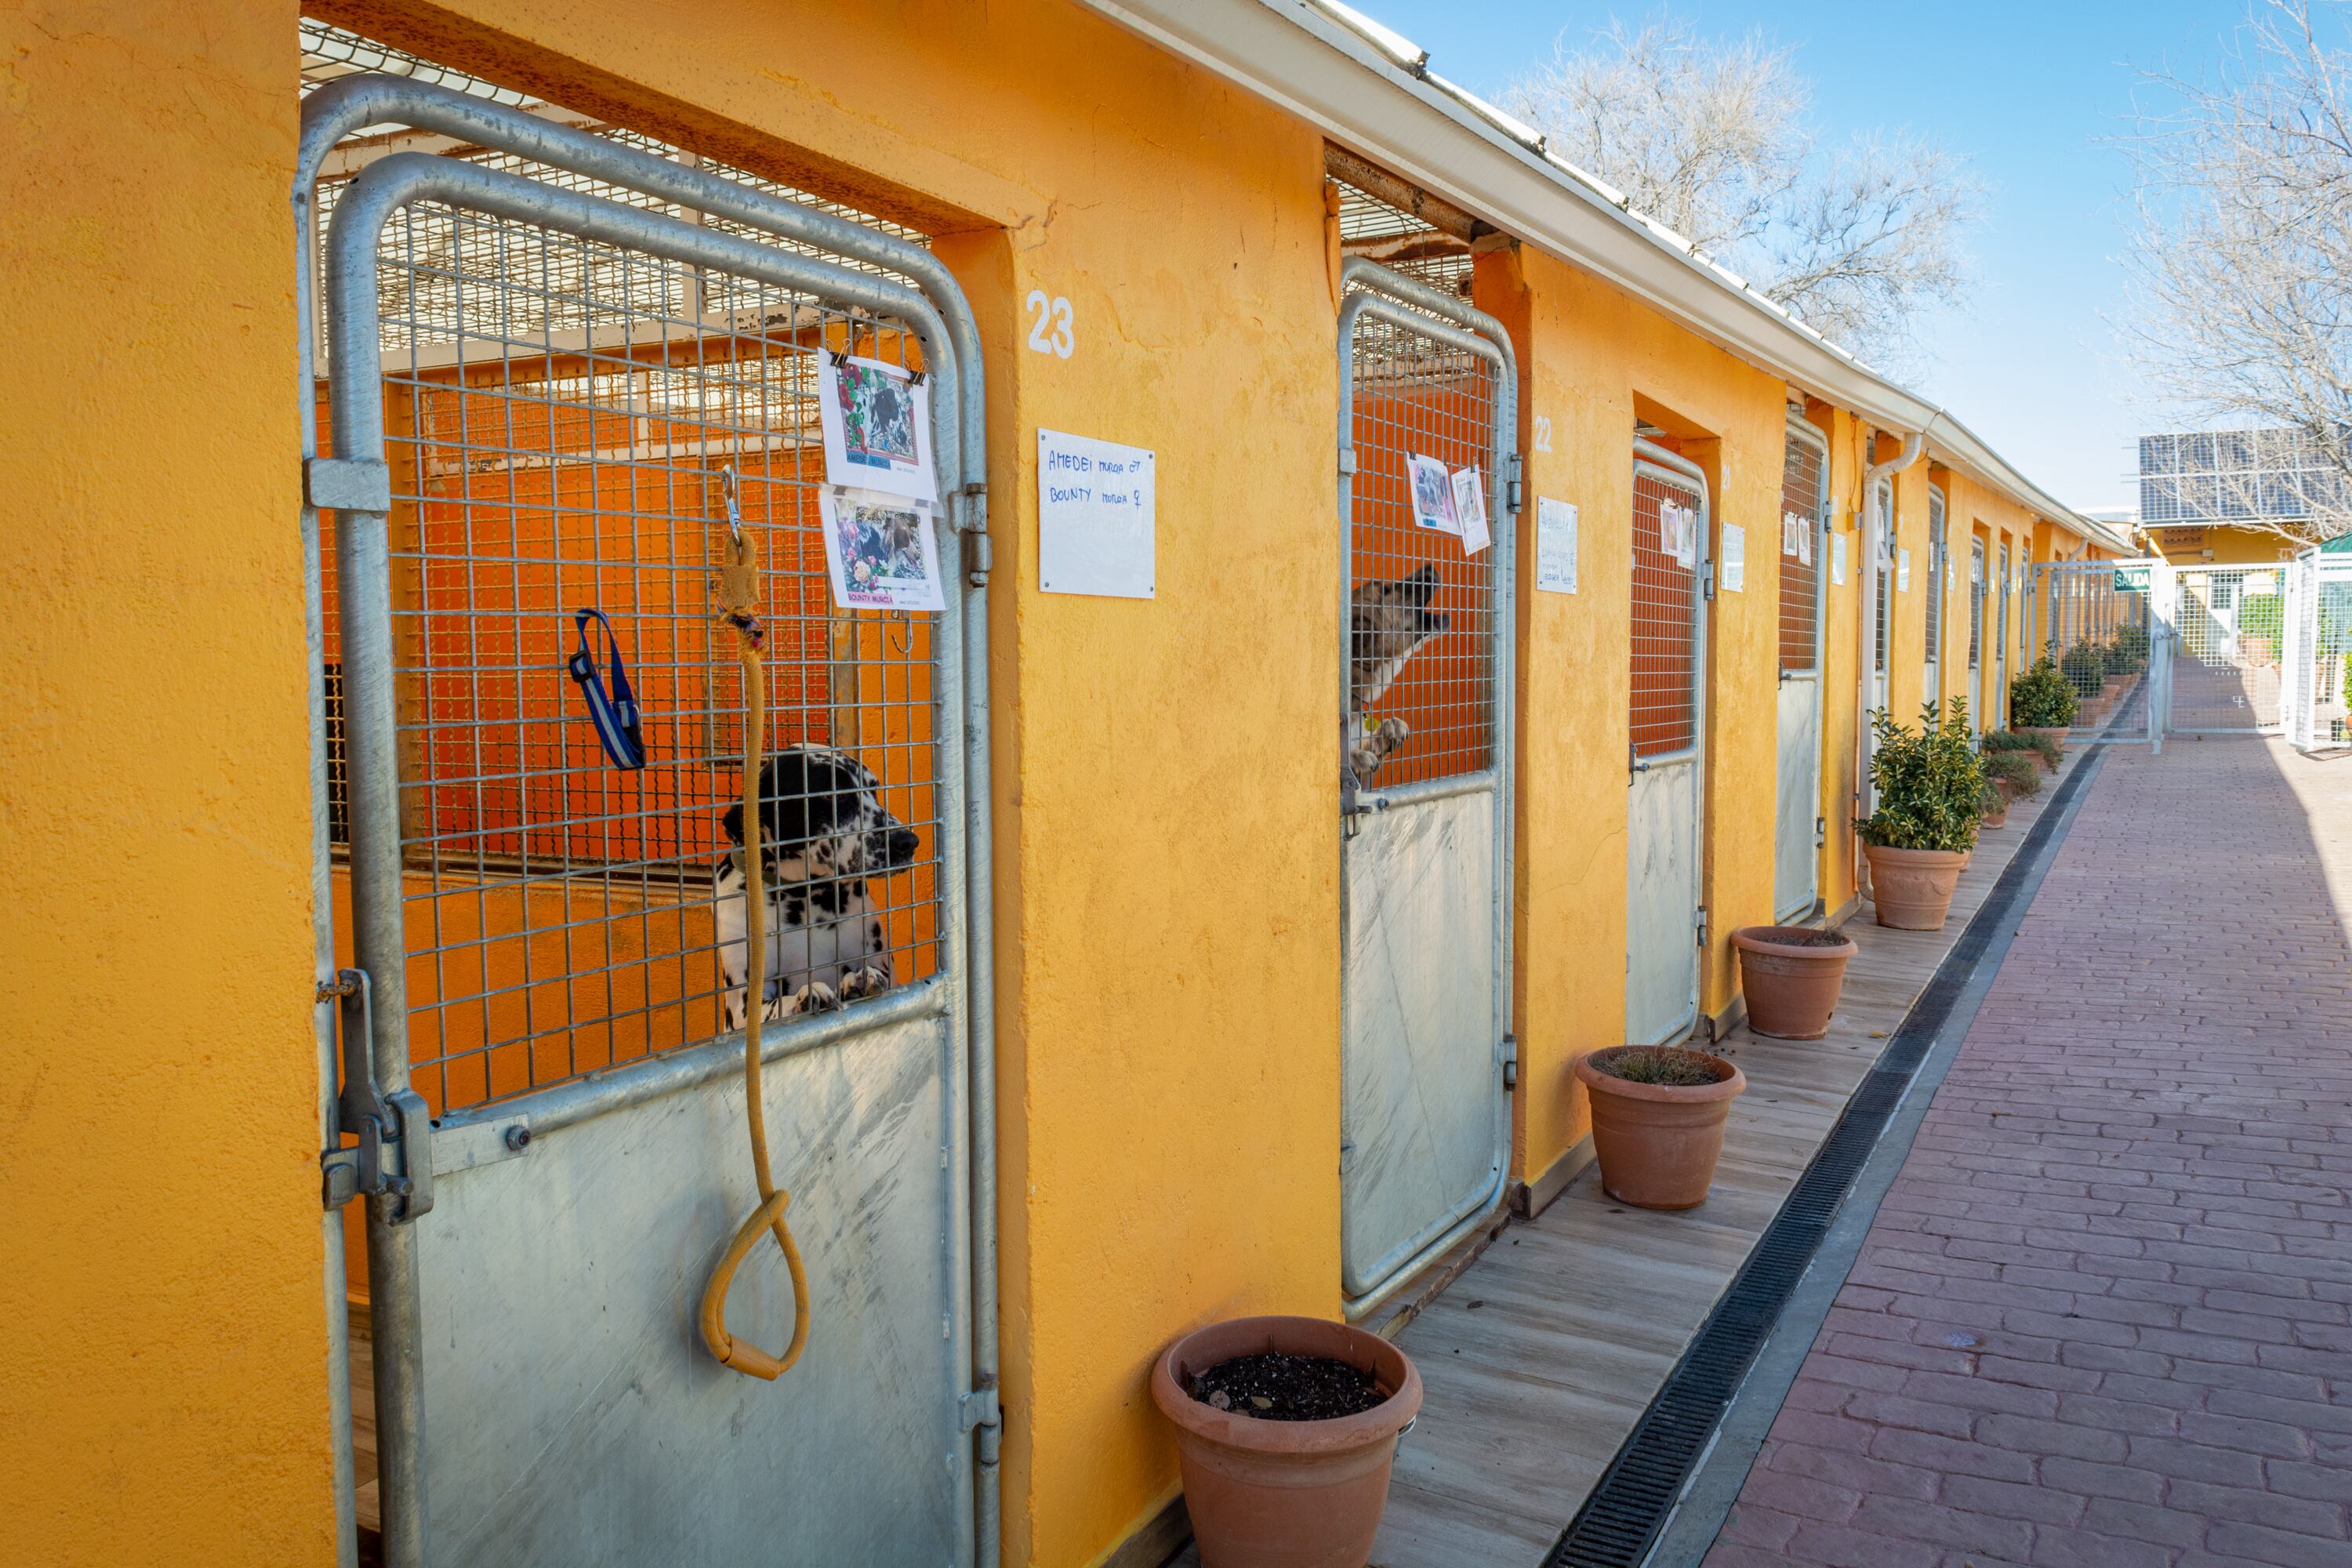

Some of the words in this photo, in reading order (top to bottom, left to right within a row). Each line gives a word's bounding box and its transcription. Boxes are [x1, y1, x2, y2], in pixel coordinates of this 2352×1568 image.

[1026, 289, 1075, 358] 23
[1535, 413, 1552, 452] 22
[847, 454, 868, 466] AMEDE
[1051, 487, 1091, 503] BOUNTY
[2116, 572, 2150, 587] SALIDA
[872, 595, 893, 604] MURCIA
